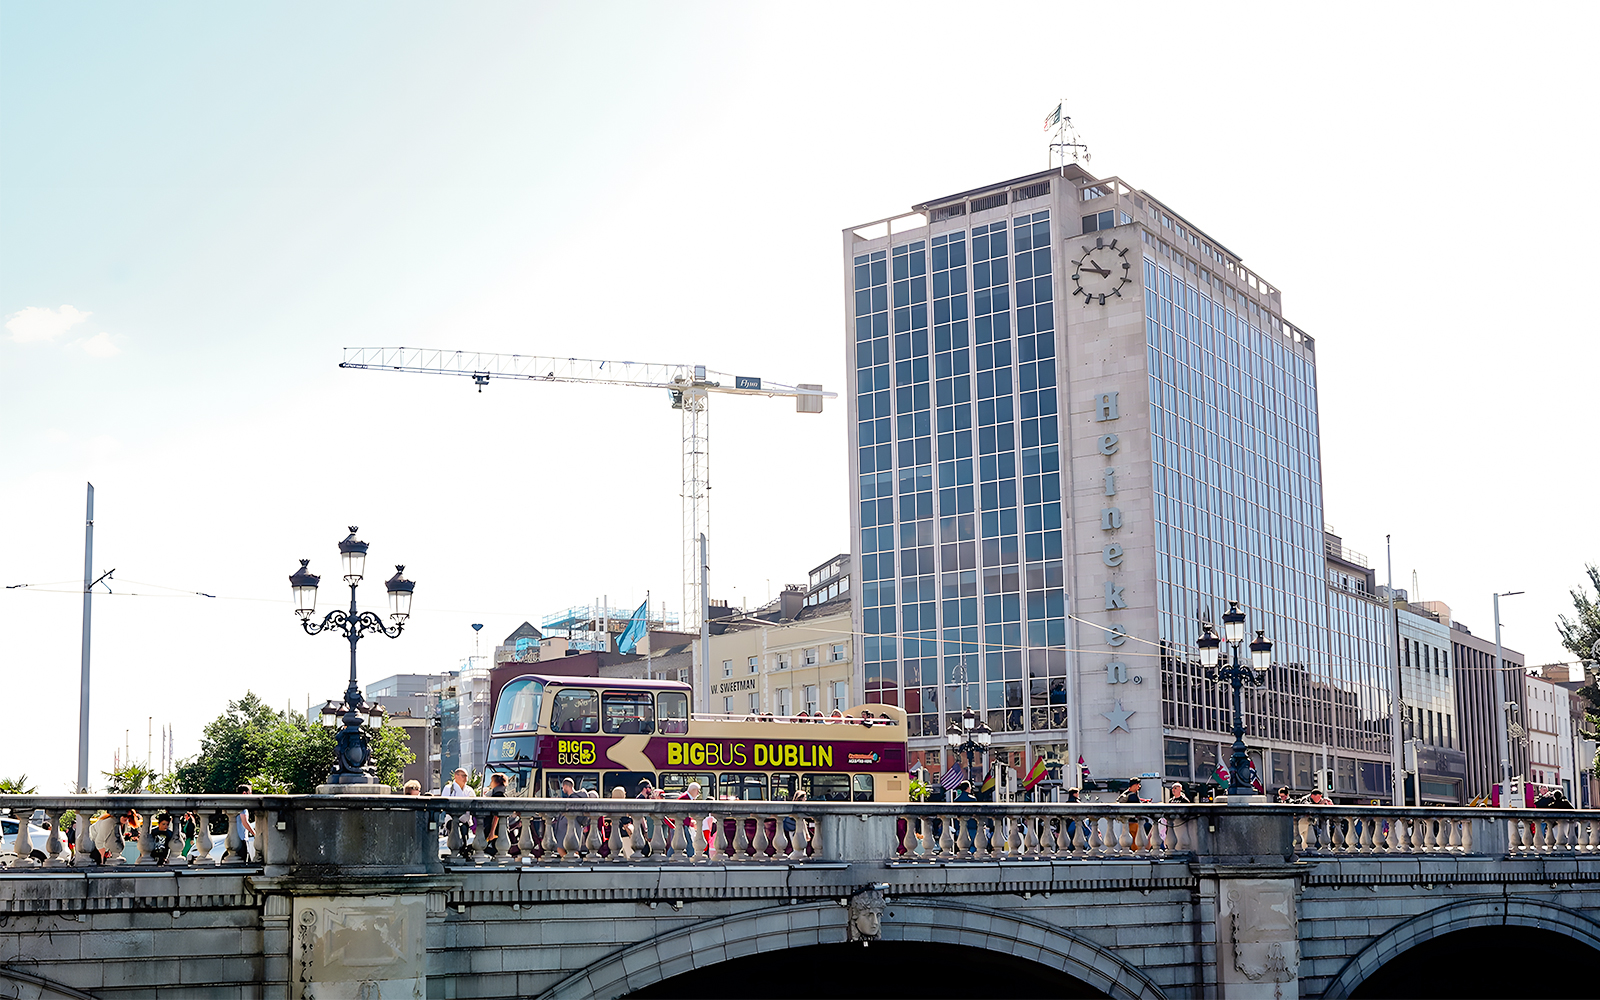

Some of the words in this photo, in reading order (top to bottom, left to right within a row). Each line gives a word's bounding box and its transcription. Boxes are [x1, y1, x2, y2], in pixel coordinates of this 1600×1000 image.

[1094, 392, 1130, 685] Heineken
[711, 684, 719, 694] W.
[720, 679, 756, 694] SWEETMAN
[558, 740, 580, 753] BIG
[558, 753, 580, 765] BUS
[754, 743, 834, 768] DUBLIN
